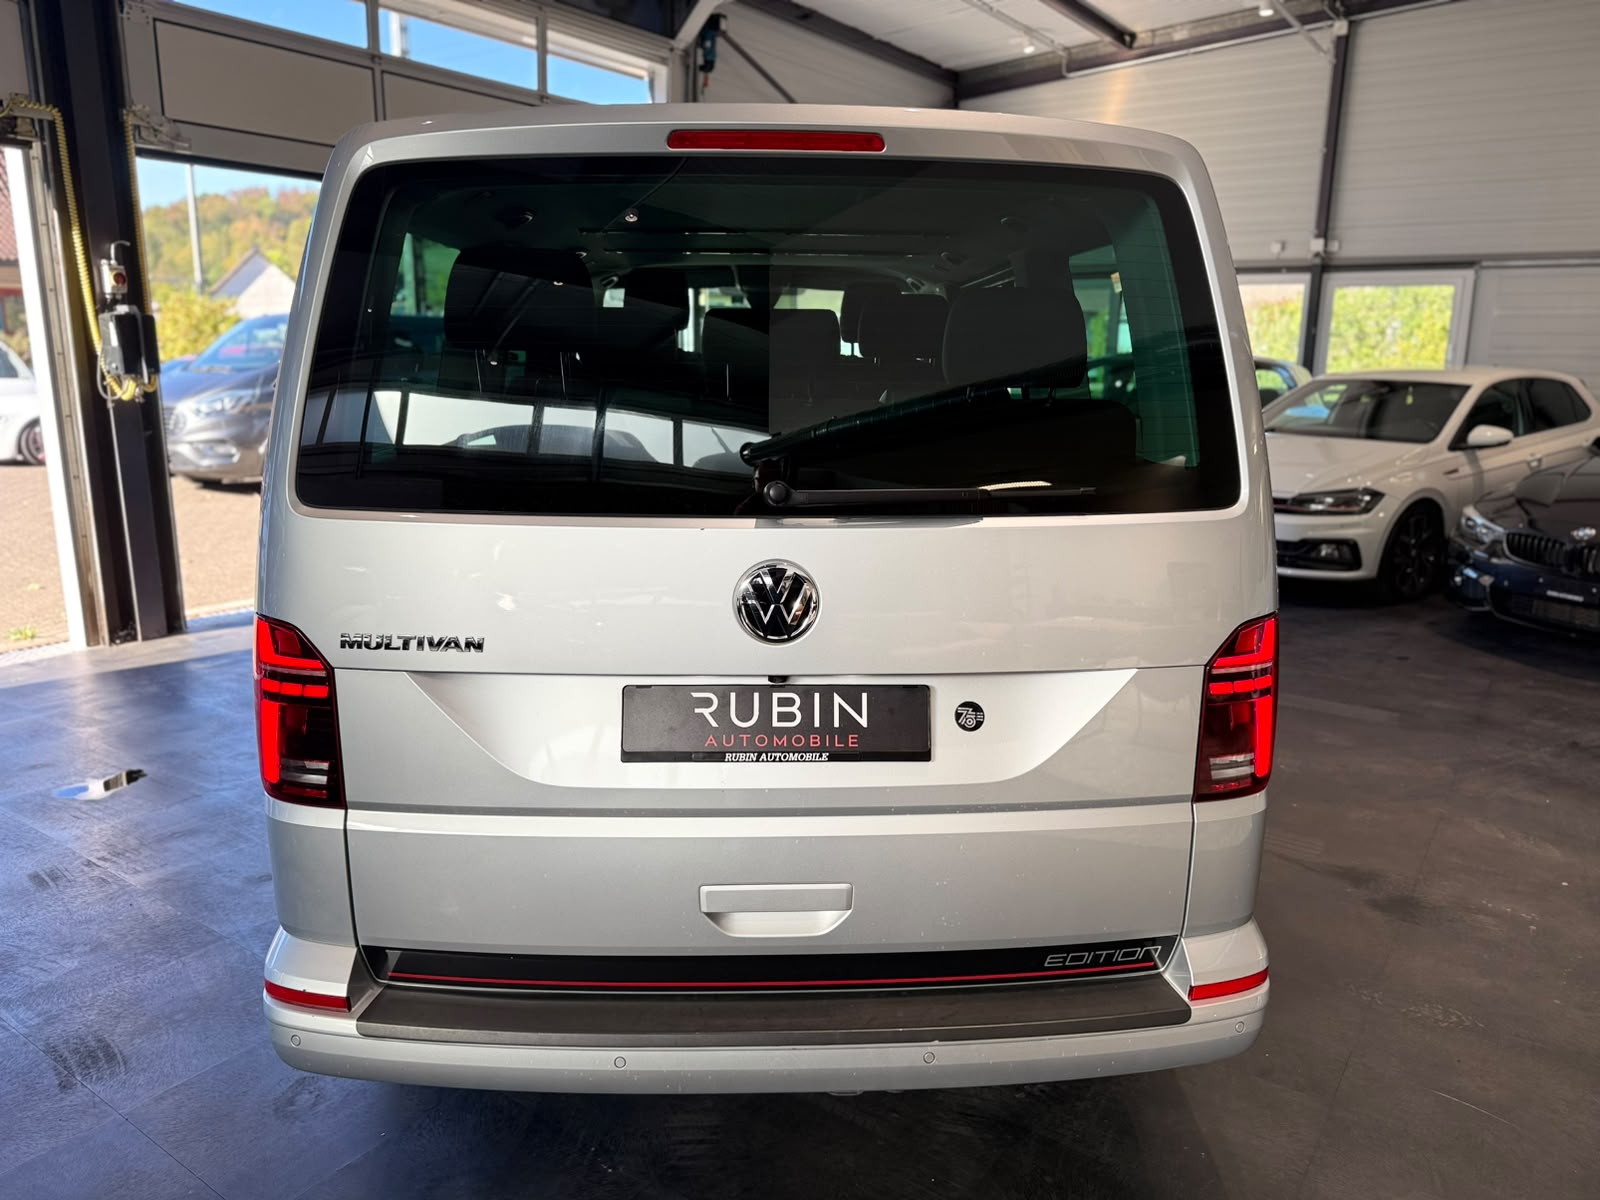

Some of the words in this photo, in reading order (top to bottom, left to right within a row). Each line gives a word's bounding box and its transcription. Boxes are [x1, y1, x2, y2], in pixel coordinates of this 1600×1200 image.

[340, 632, 485, 653] MULTIVAN
[690, 691, 868, 728] RUBIN
[704, 734, 859, 747] AUTOMOBILE
[724, 752, 757, 762] RUBIN
[758, 752, 829, 762] AUTOMOBILE
[1043, 945, 1162, 967] EDITION
